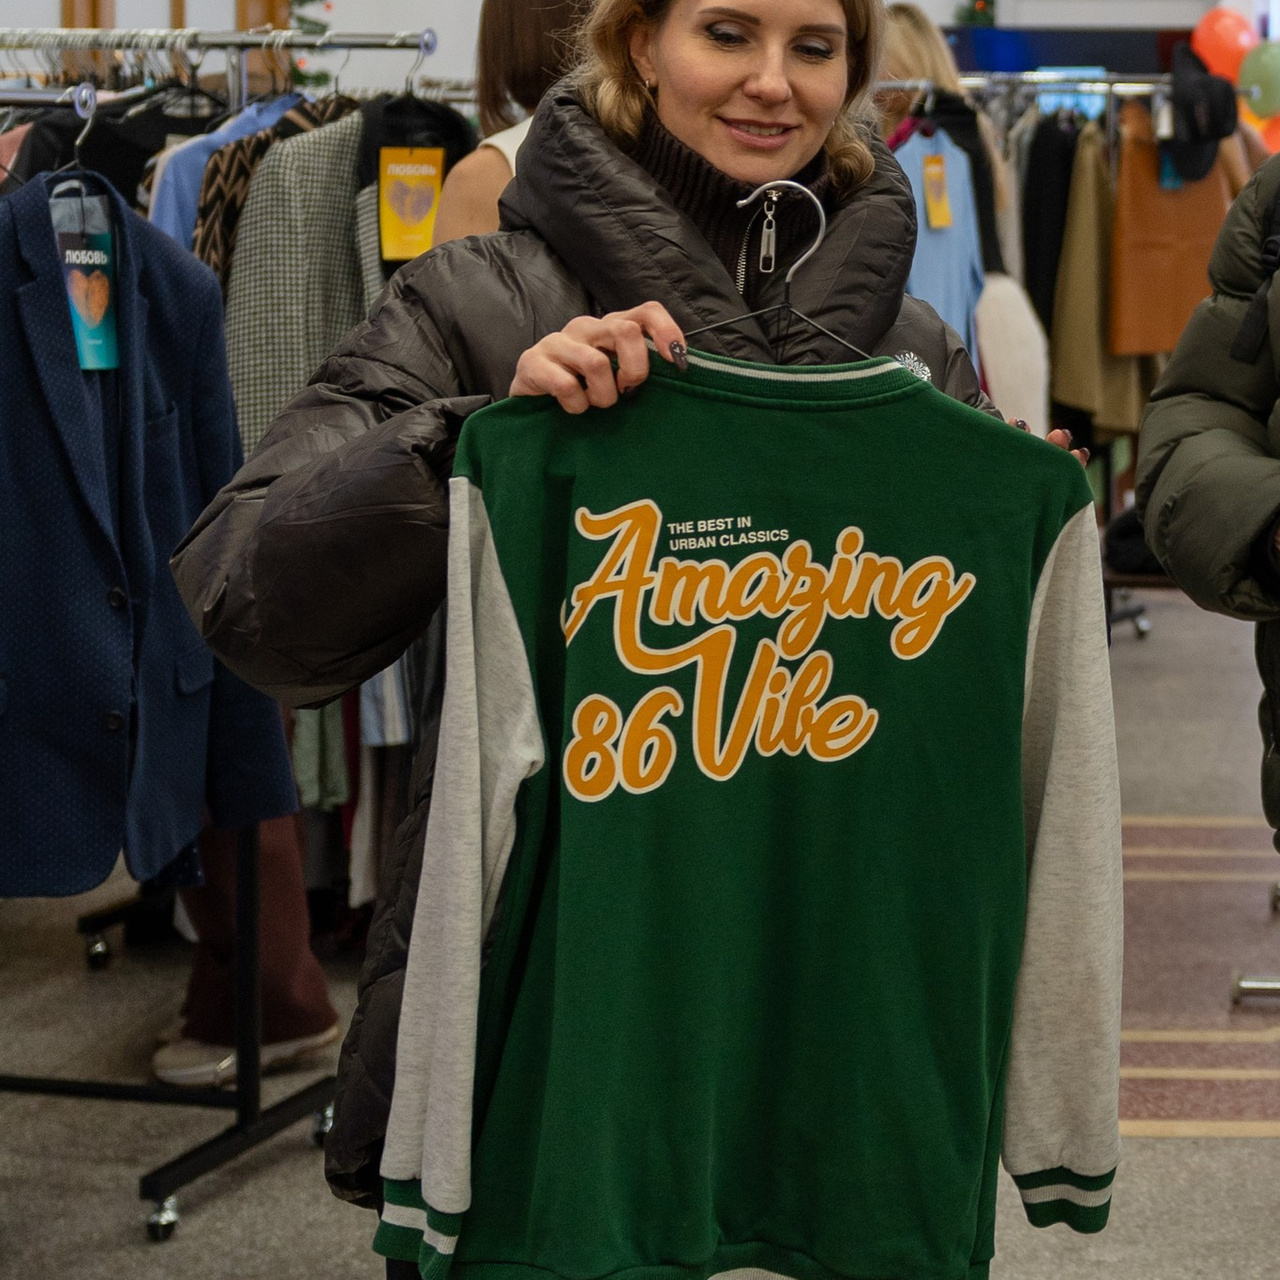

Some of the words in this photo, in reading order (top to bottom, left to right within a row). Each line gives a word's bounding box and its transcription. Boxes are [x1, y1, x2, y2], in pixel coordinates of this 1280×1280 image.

[65, 249, 109, 265] ЛЮБОВЬ
[667, 521, 694, 535] THE
[697, 518, 734, 532] BEST
[737, 516, 752, 528] IN
[669, 536, 716, 551] URBAN
[719, 529, 789, 546] CLASSICS
[560, 499, 976, 675] Amazing
[563, 686, 683, 802] 86
[692, 624, 878, 781] Vibe
